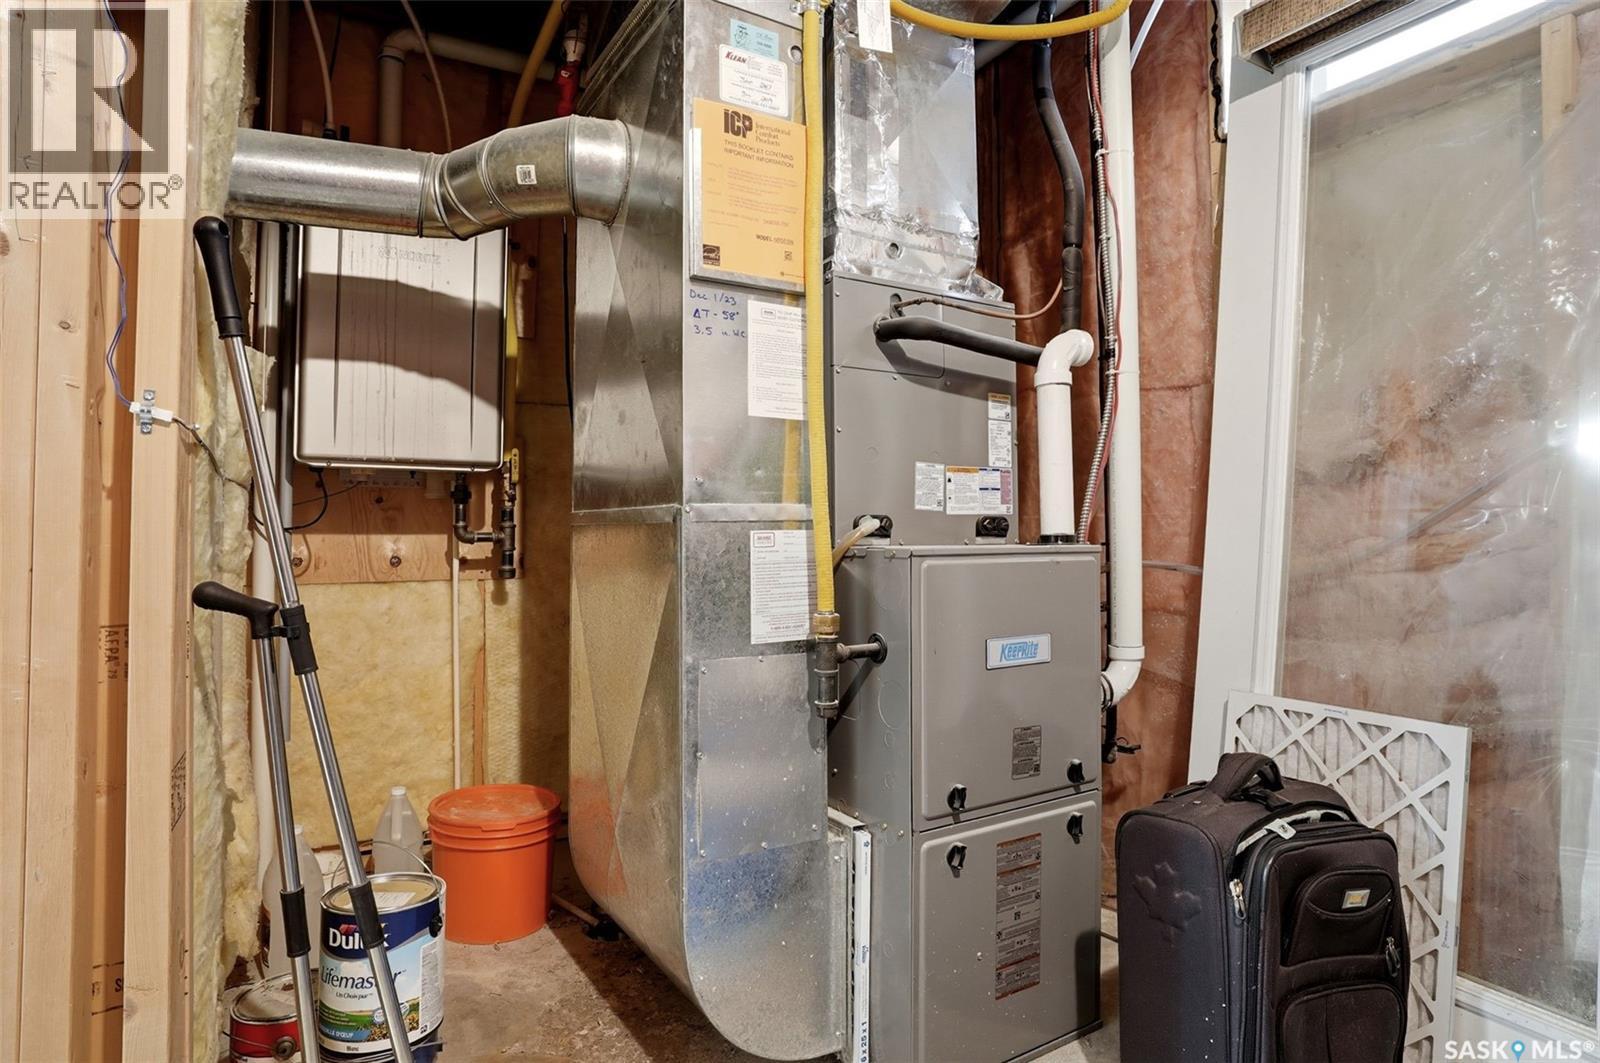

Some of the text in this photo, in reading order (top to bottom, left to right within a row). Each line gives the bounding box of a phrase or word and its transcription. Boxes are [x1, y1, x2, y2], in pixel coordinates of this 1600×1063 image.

[724, 148, 794, 168] IMPORTANT INFORMATION
[738, 143, 763, 155] BOOKLET
[689, 289, 708, 300] Dec
[329, 928, 390, 950] Dul
[321, 966, 402, 990] Lifemasr
